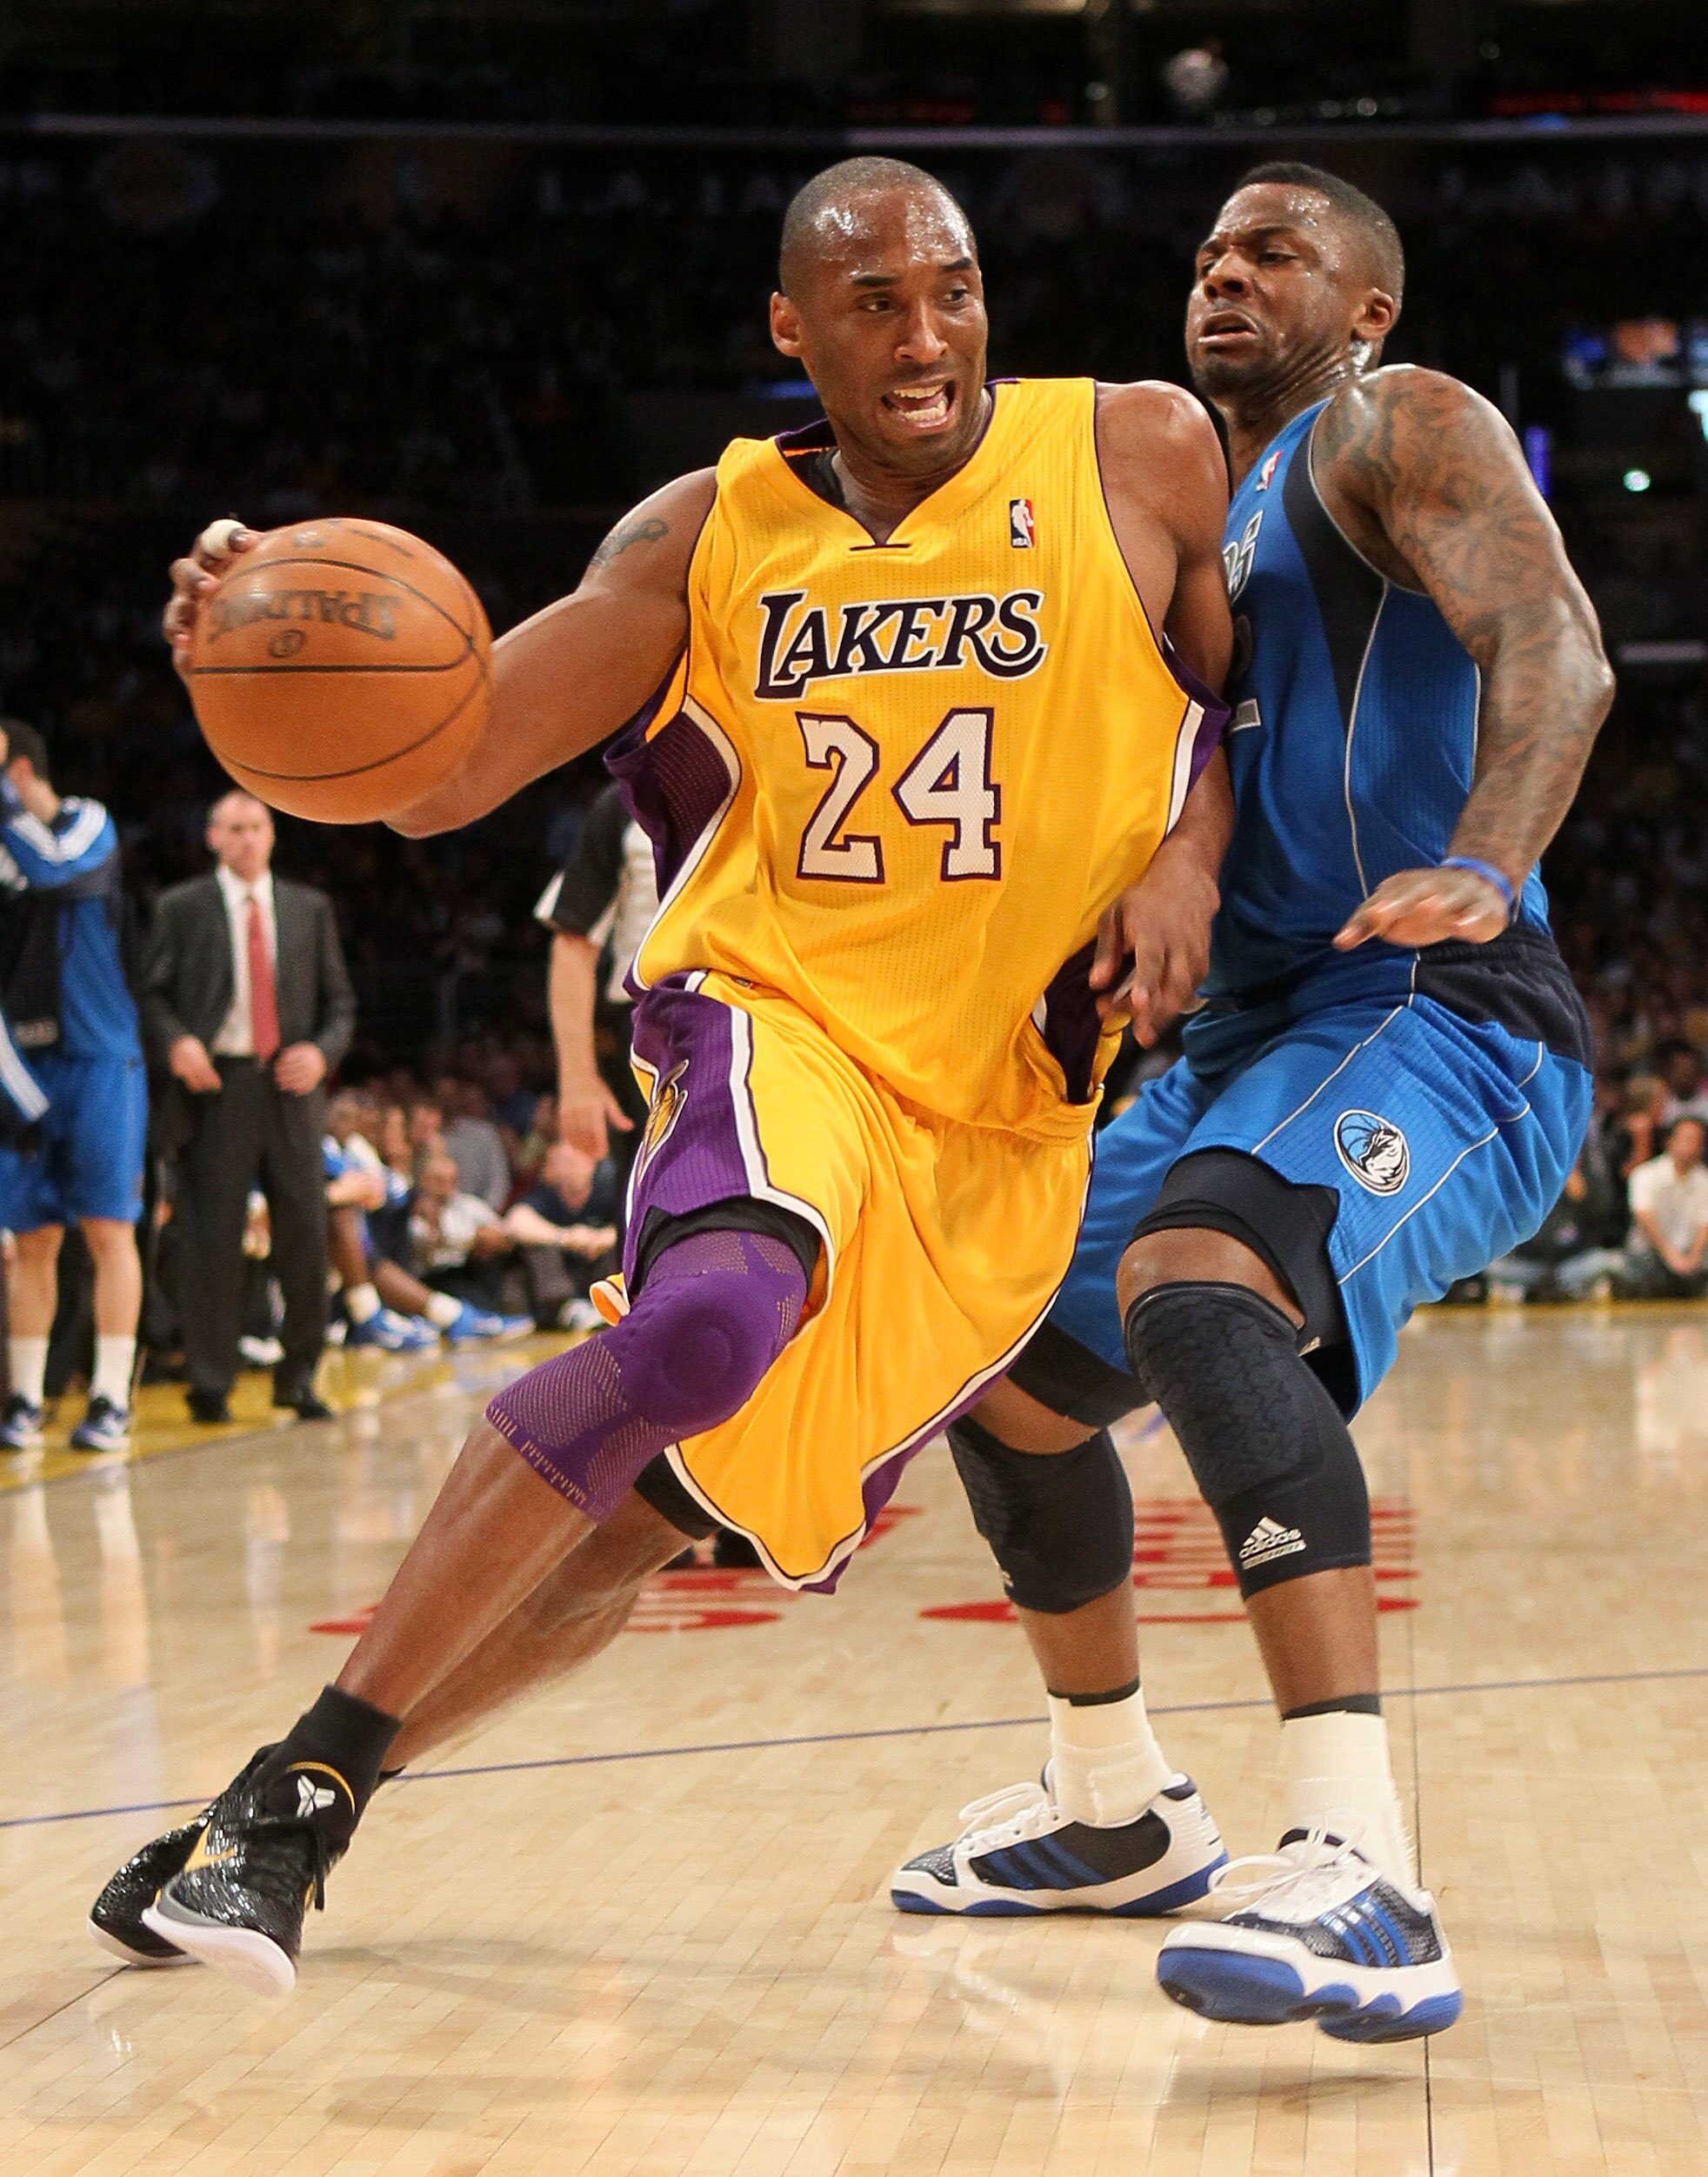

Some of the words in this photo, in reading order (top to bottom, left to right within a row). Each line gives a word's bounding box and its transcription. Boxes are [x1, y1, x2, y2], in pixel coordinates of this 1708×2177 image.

[208, 590, 402, 642] SPALD
[754, 588, 1049, 703] LAKERS
[795, 707, 1001, 884] 24
[1238, 1528, 1302, 1559] adidas
